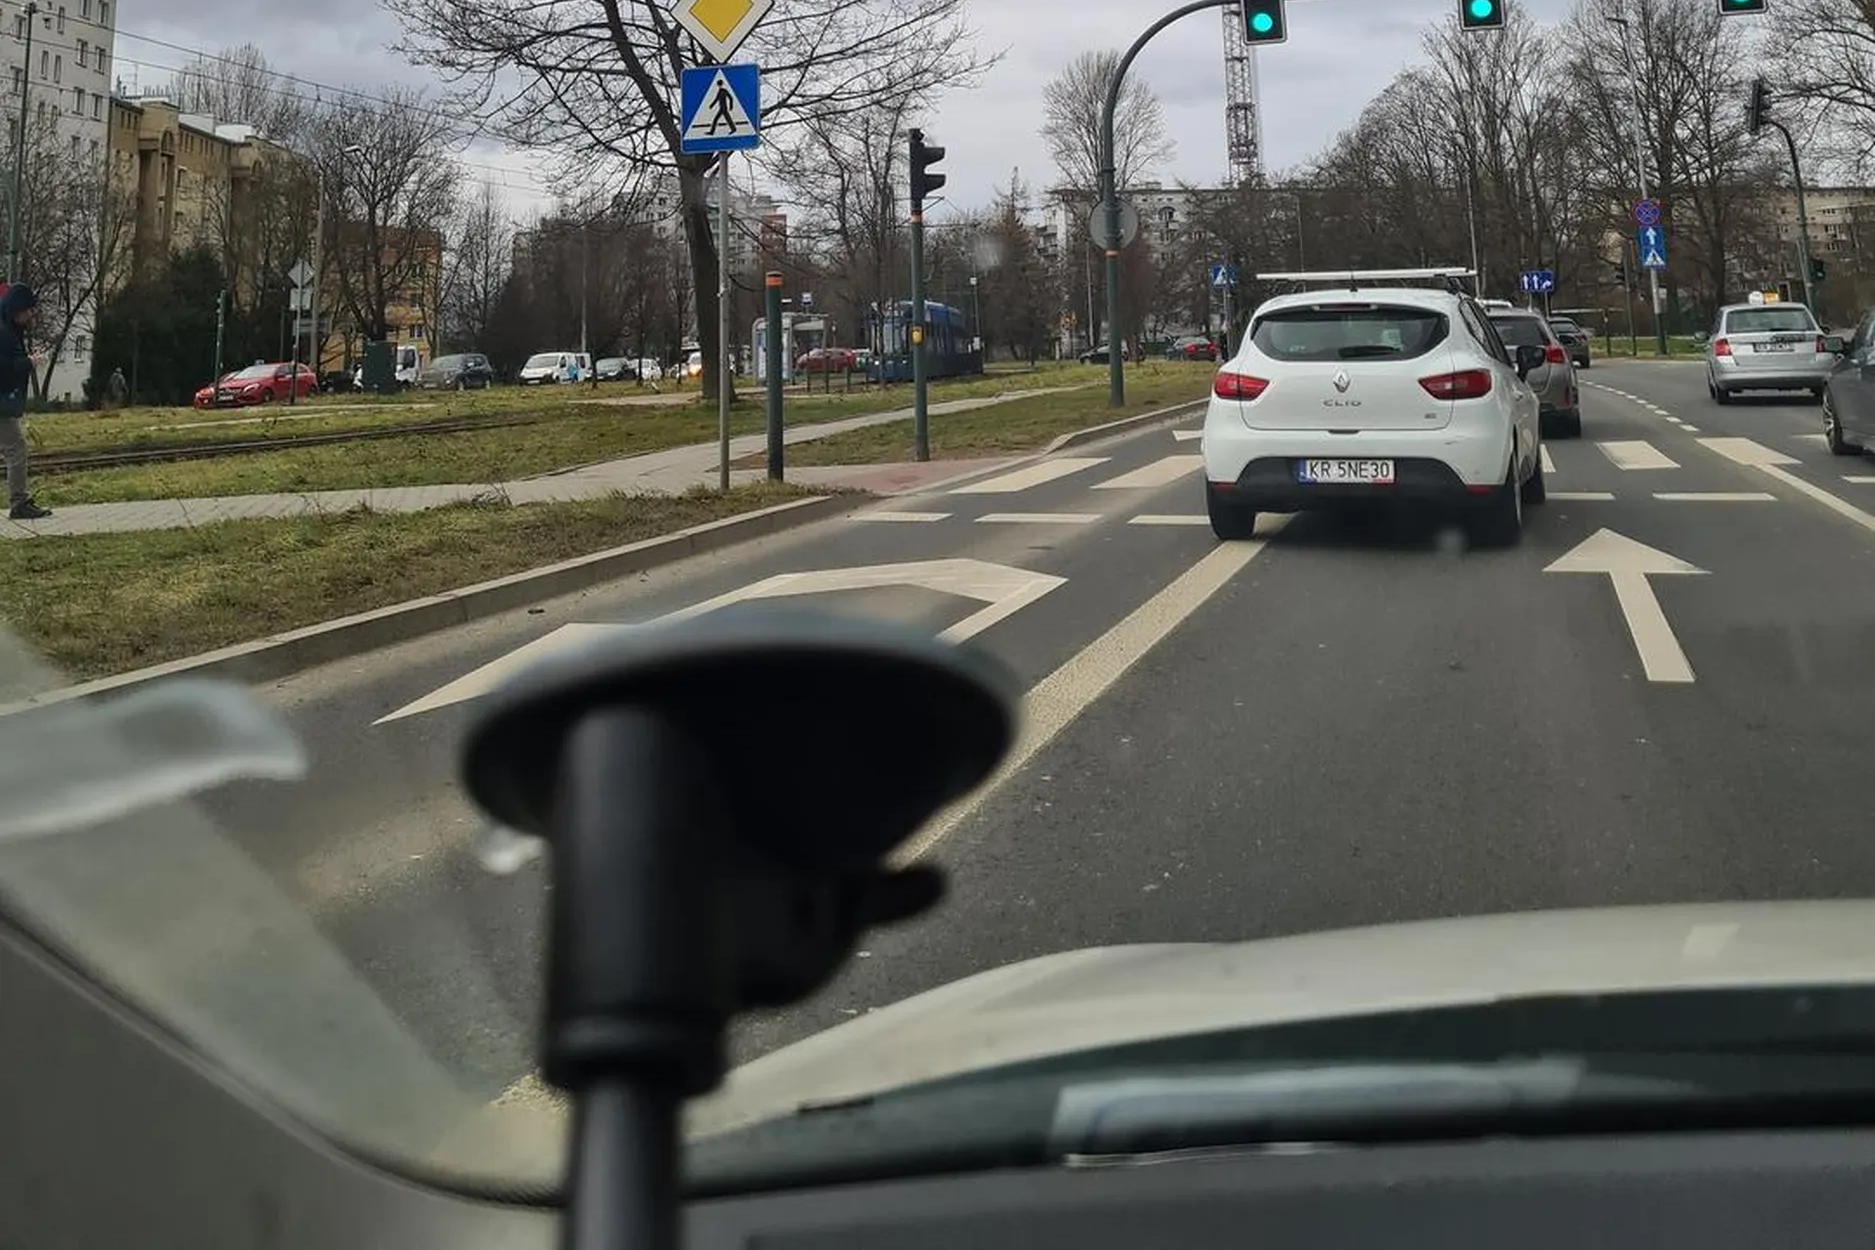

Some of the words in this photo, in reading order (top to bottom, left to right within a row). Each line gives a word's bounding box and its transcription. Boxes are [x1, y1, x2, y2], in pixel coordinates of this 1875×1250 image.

[1323, 399, 1362, 407] CLIO
[1310, 461, 1331, 479] KR
[1338, 461, 1390, 479] 5NE30
